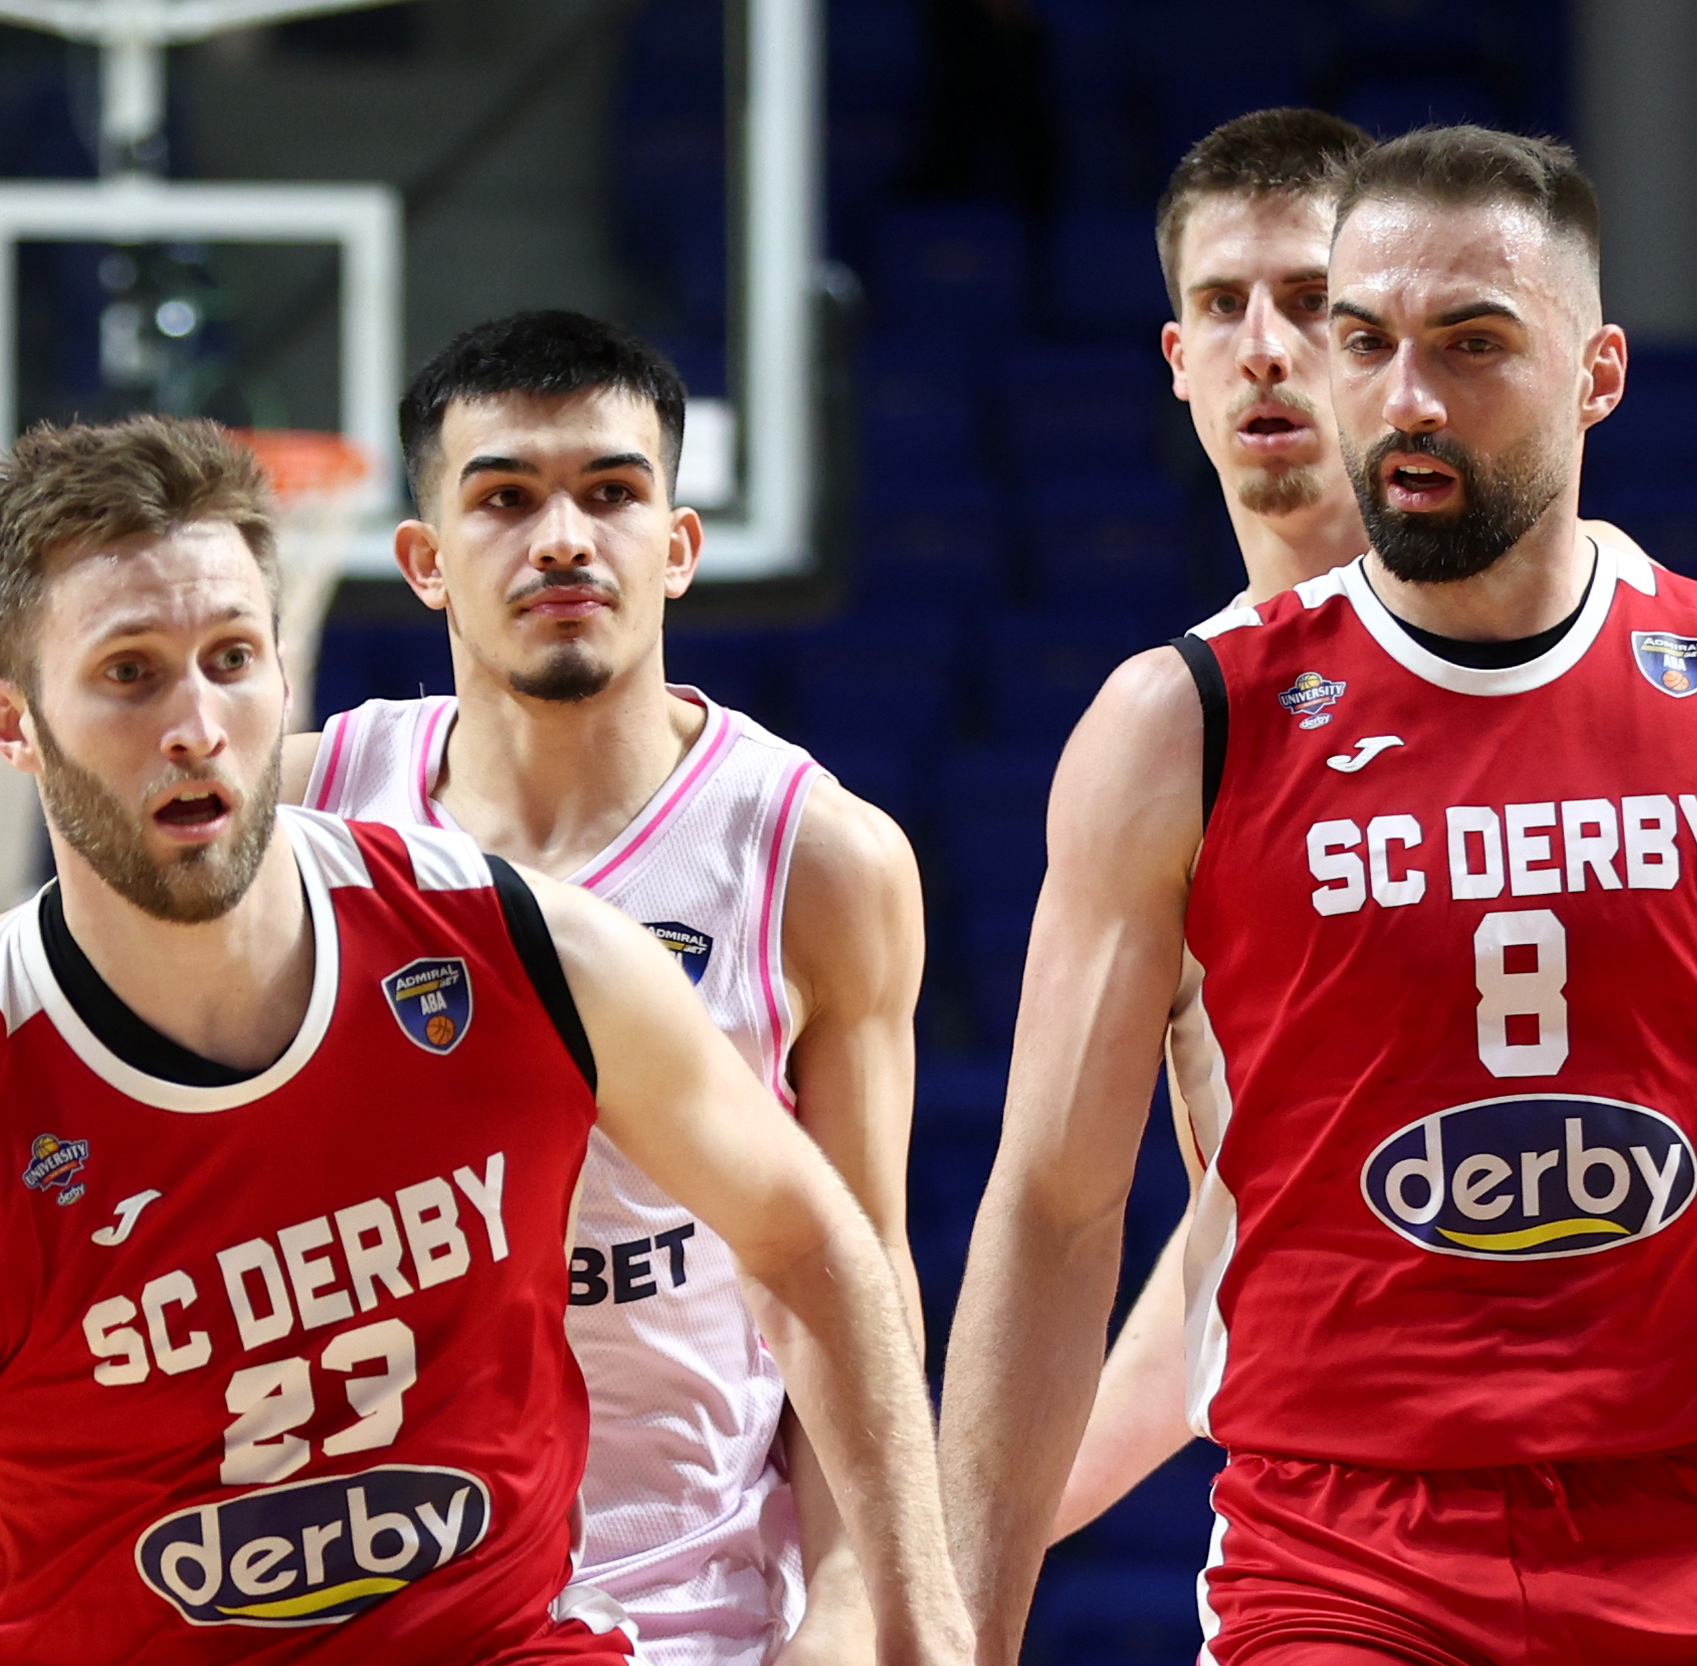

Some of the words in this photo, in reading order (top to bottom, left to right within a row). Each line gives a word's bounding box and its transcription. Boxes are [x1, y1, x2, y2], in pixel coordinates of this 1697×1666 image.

[1280, 684, 1344, 706] UNIVERSITY
[1305, 814, 1426, 916] SC
[396, 963, 459, 991] ADMIRAL
[420, 990, 447, 1015] ABA
[1473, 908, 1569, 1078] 8
[25, 1144, 85, 1185] UNIVERSITY
[1384, 1116, 1682, 1234] derby
[82, 1269, 213, 1387] SC
[215, 1152, 508, 1351] DERBY
[567, 1222, 695, 1305] BET
[220, 1318, 418, 1485] 23
[159, 1485, 470, 1607] derby
